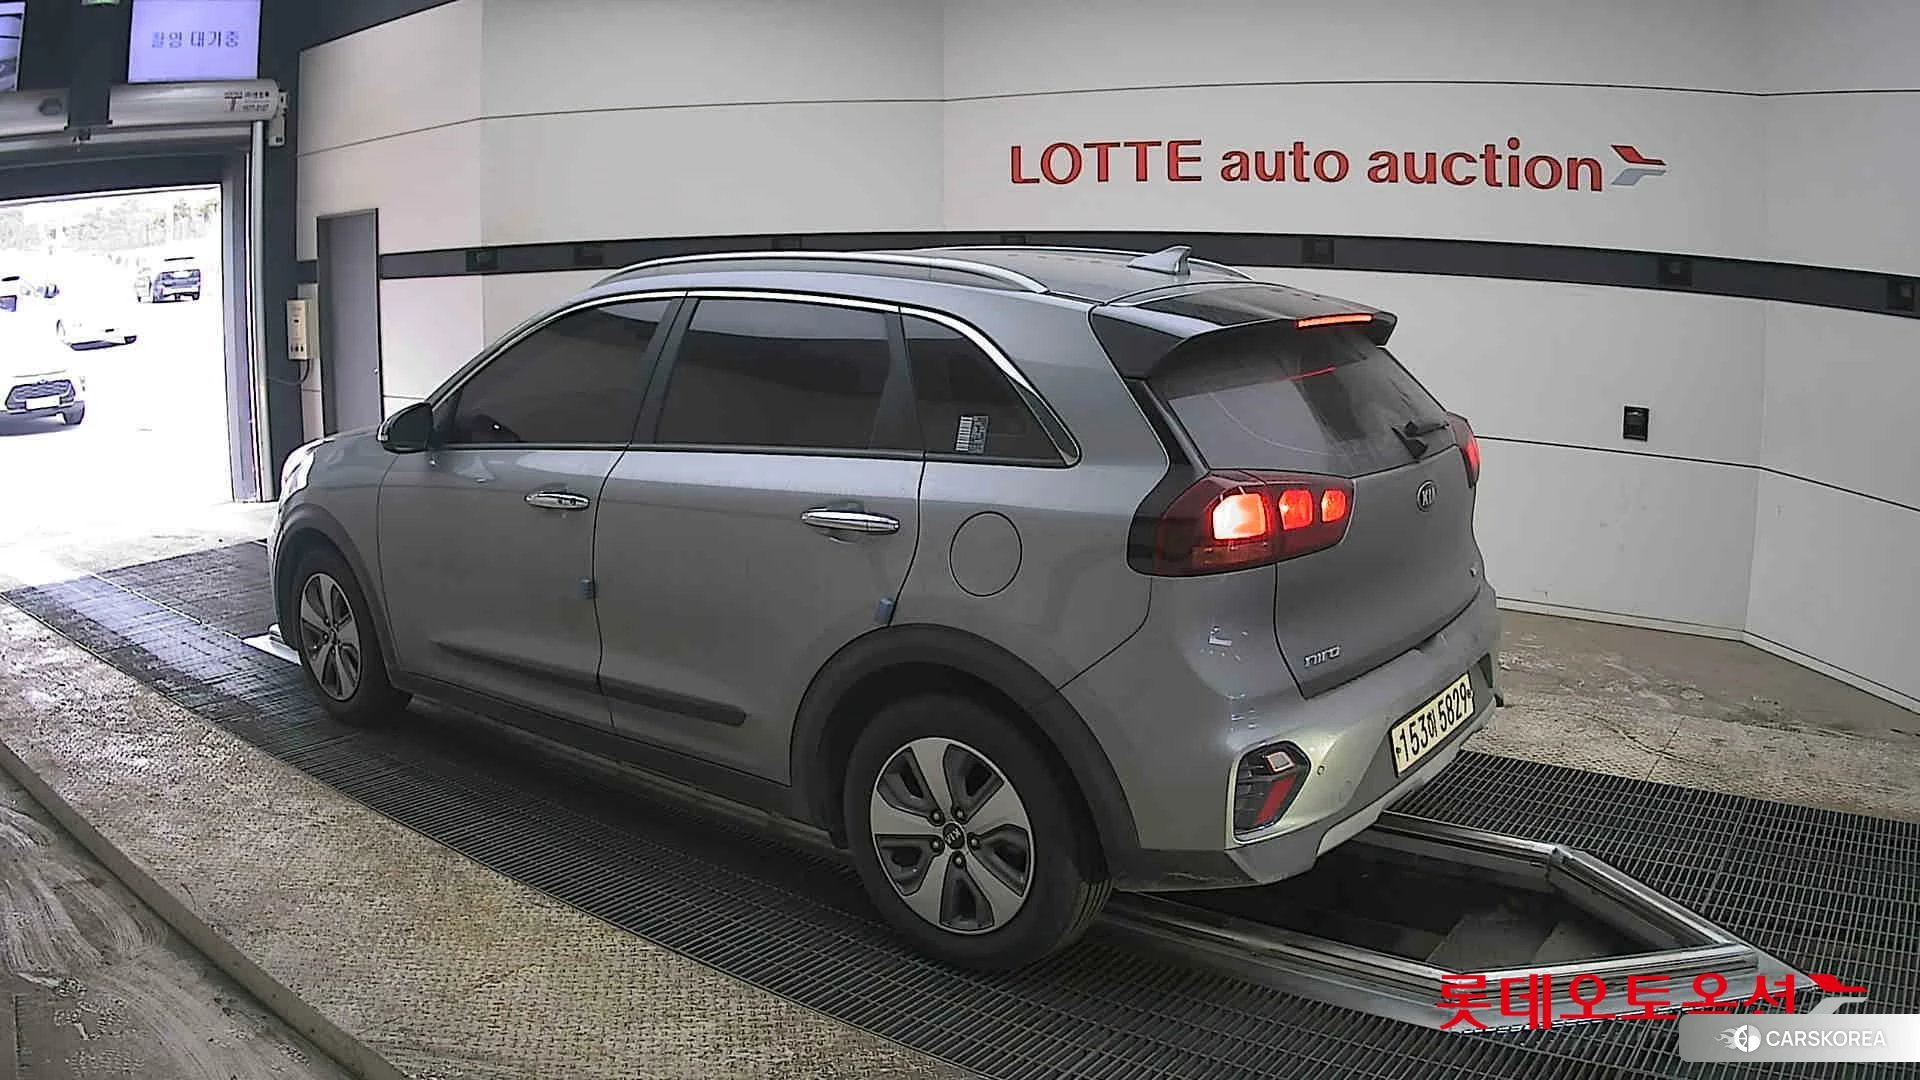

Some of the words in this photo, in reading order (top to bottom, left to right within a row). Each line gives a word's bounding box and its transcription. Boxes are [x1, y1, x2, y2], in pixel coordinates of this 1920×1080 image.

[191, 31, 240, 48] 대기중
[1010, 139, 1201, 186] LOTTE
[1221, 140, 1351, 183] auto
[1367, 138, 1603, 192] auction
[1438, 682, 1467, 732] 5829
